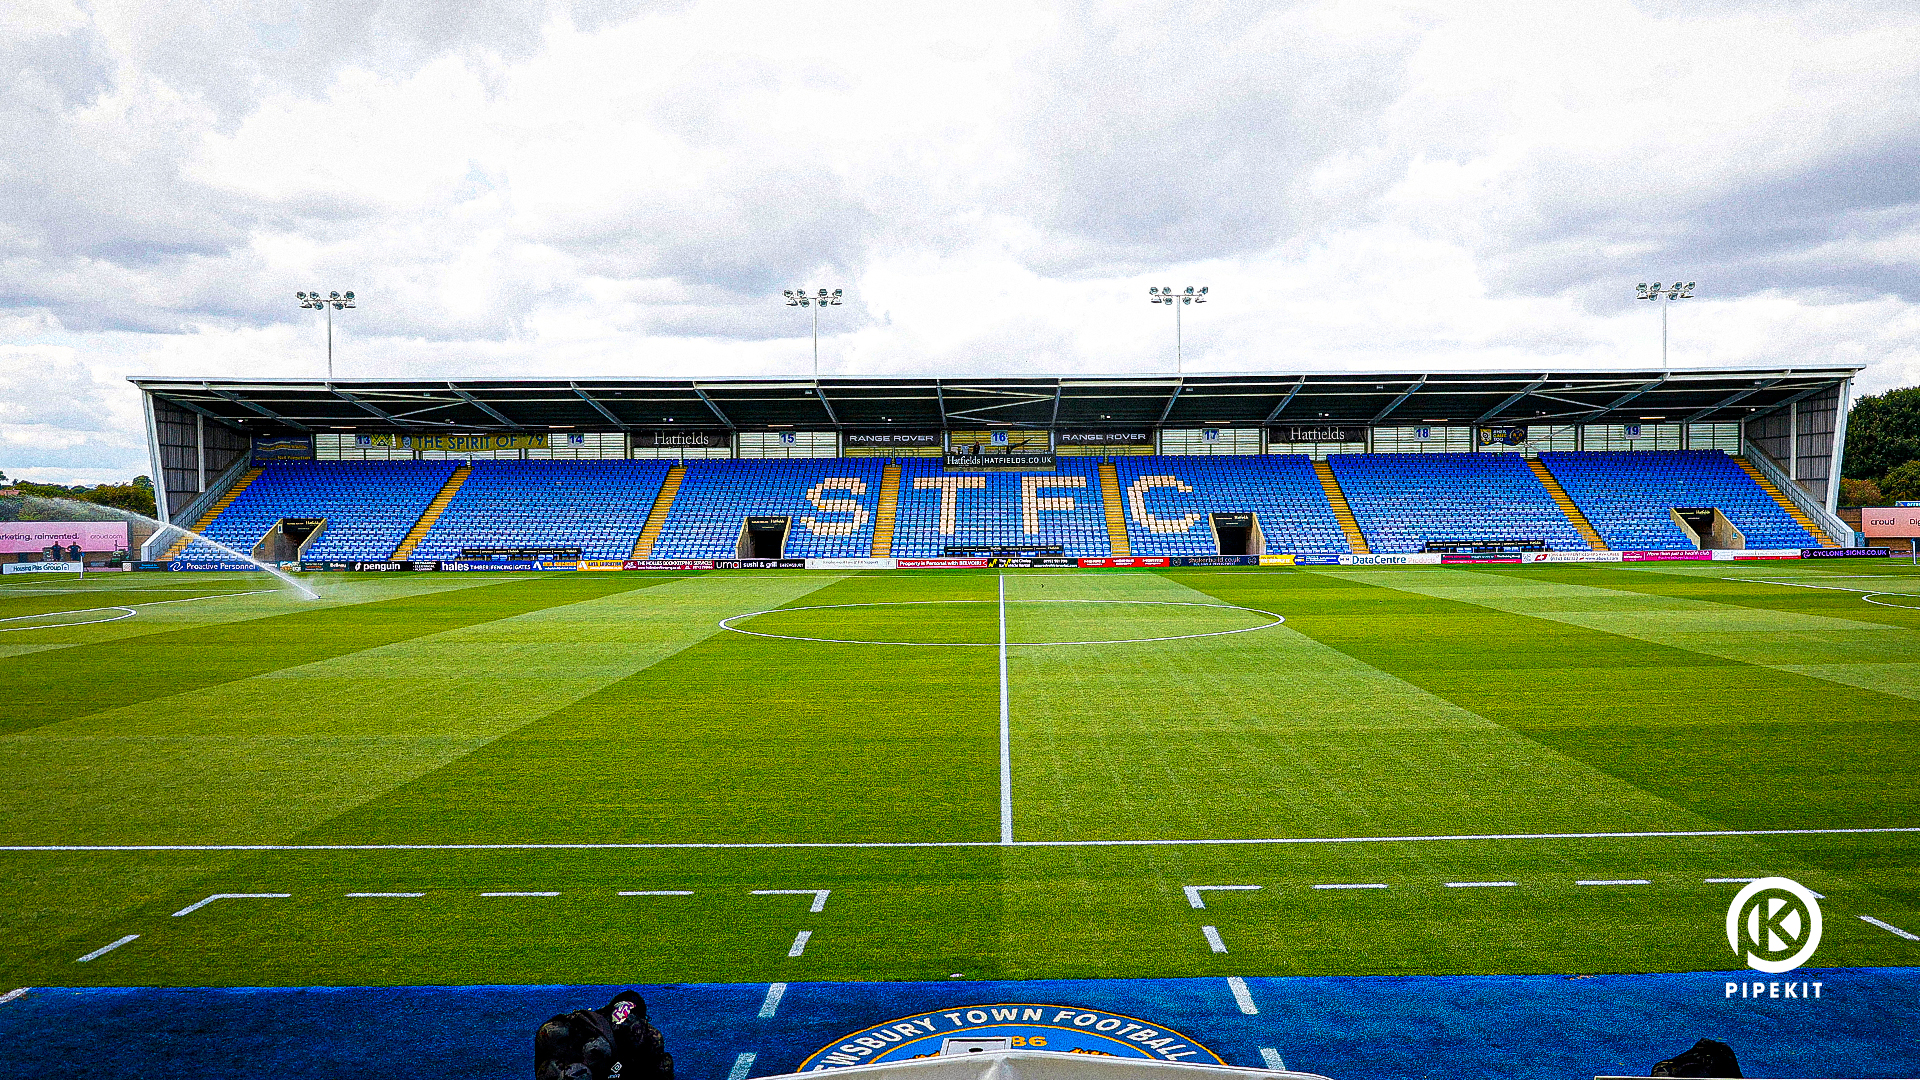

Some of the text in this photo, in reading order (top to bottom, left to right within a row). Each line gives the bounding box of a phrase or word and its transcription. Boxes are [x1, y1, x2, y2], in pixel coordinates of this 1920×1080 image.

[1204, 431, 1217, 440] 17
[1290, 427, 1345, 440] Hatfields
[1416, 428, 1429, 437] 18
[1625, 426, 1639, 436] 19
[356, 434, 371, 445] 13
[569, 434, 583, 444] 14
[654, 431, 709, 445] Hatfields
[781, 433, 794, 443] 15
[993, 432, 1006, 442] 16
[418, 436, 443, 449] THE
[448, 436, 491, 450] SPIRIT
[496, 435, 517, 448] OF
[947, 456, 1052, 465] Hatfields HATFIELDS.CO.UK
[1870, 518, 1896, 526] croud
[1812, 549, 1887, 557] CYCLONE-SIGNS.CO.UK
[716, 560, 741, 569] umai
[766, 561, 777, 569] grill
[1352, 555, 1407, 565] DataCentre
[186, 562, 218, 570] Proactive
[220, 562, 256, 570] Personnel
[363, 561, 401, 571] penguin
[441, 561, 469, 571] hales
[813, 1008, 1198, 1071] WSBURY TOWN FOOTBALL
